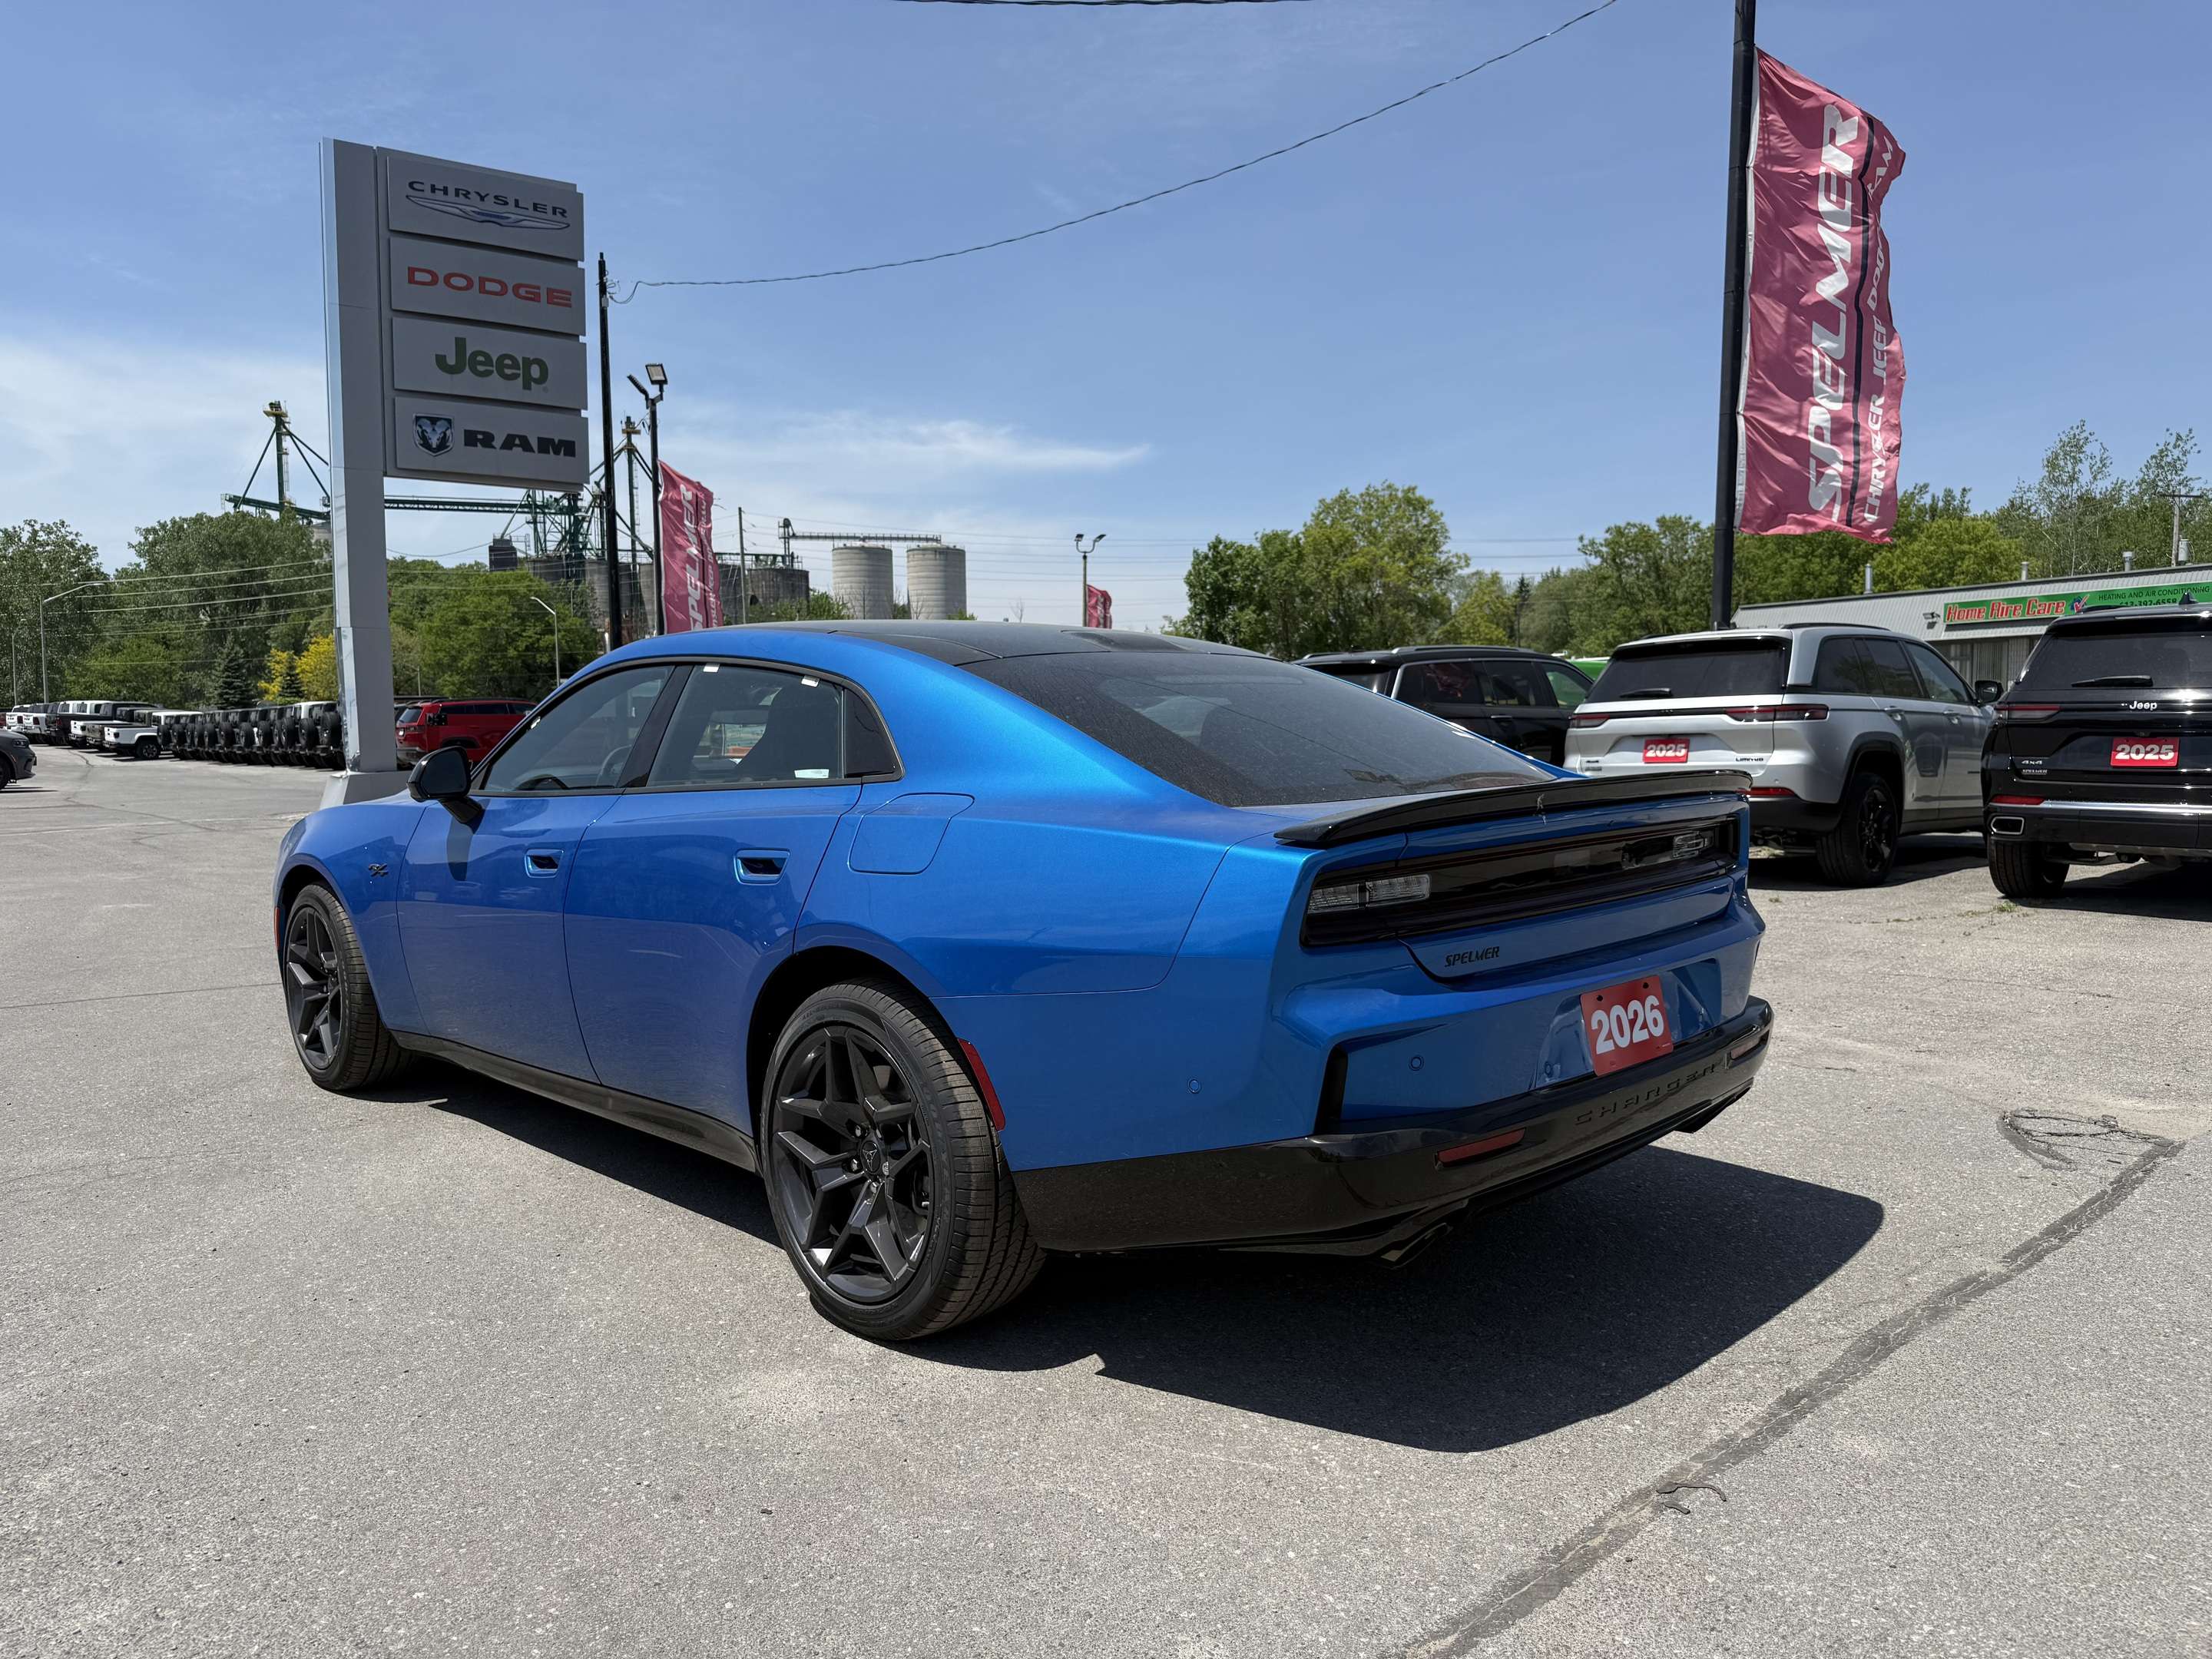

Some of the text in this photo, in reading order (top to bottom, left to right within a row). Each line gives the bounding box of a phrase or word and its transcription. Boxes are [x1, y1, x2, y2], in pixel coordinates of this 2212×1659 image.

[408, 180, 568, 218] CHRYSLER
[407, 266, 572, 307] DODGE
[1808, 104, 1859, 523] SPELMER
[435, 336, 548, 390] Jeep
[1873, 315, 1887, 385] JEEP
[464, 429, 576, 458] RAM
[1946, 604, 1986, 622] Home
[2025, 598, 2066, 615] Care
[2098, 592, 2127, 601] HEATING
[2129, 700, 2157, 711] Jeep
[1645, 743, 1687, 757] 2025
[2114, 743, 2174, 760] 2025
[1445, 946, 1500, 967] SPELMER
[1591, 995, 1664, 1055] 2026
[1575, 1064, 1715, 1125] CHARGER
